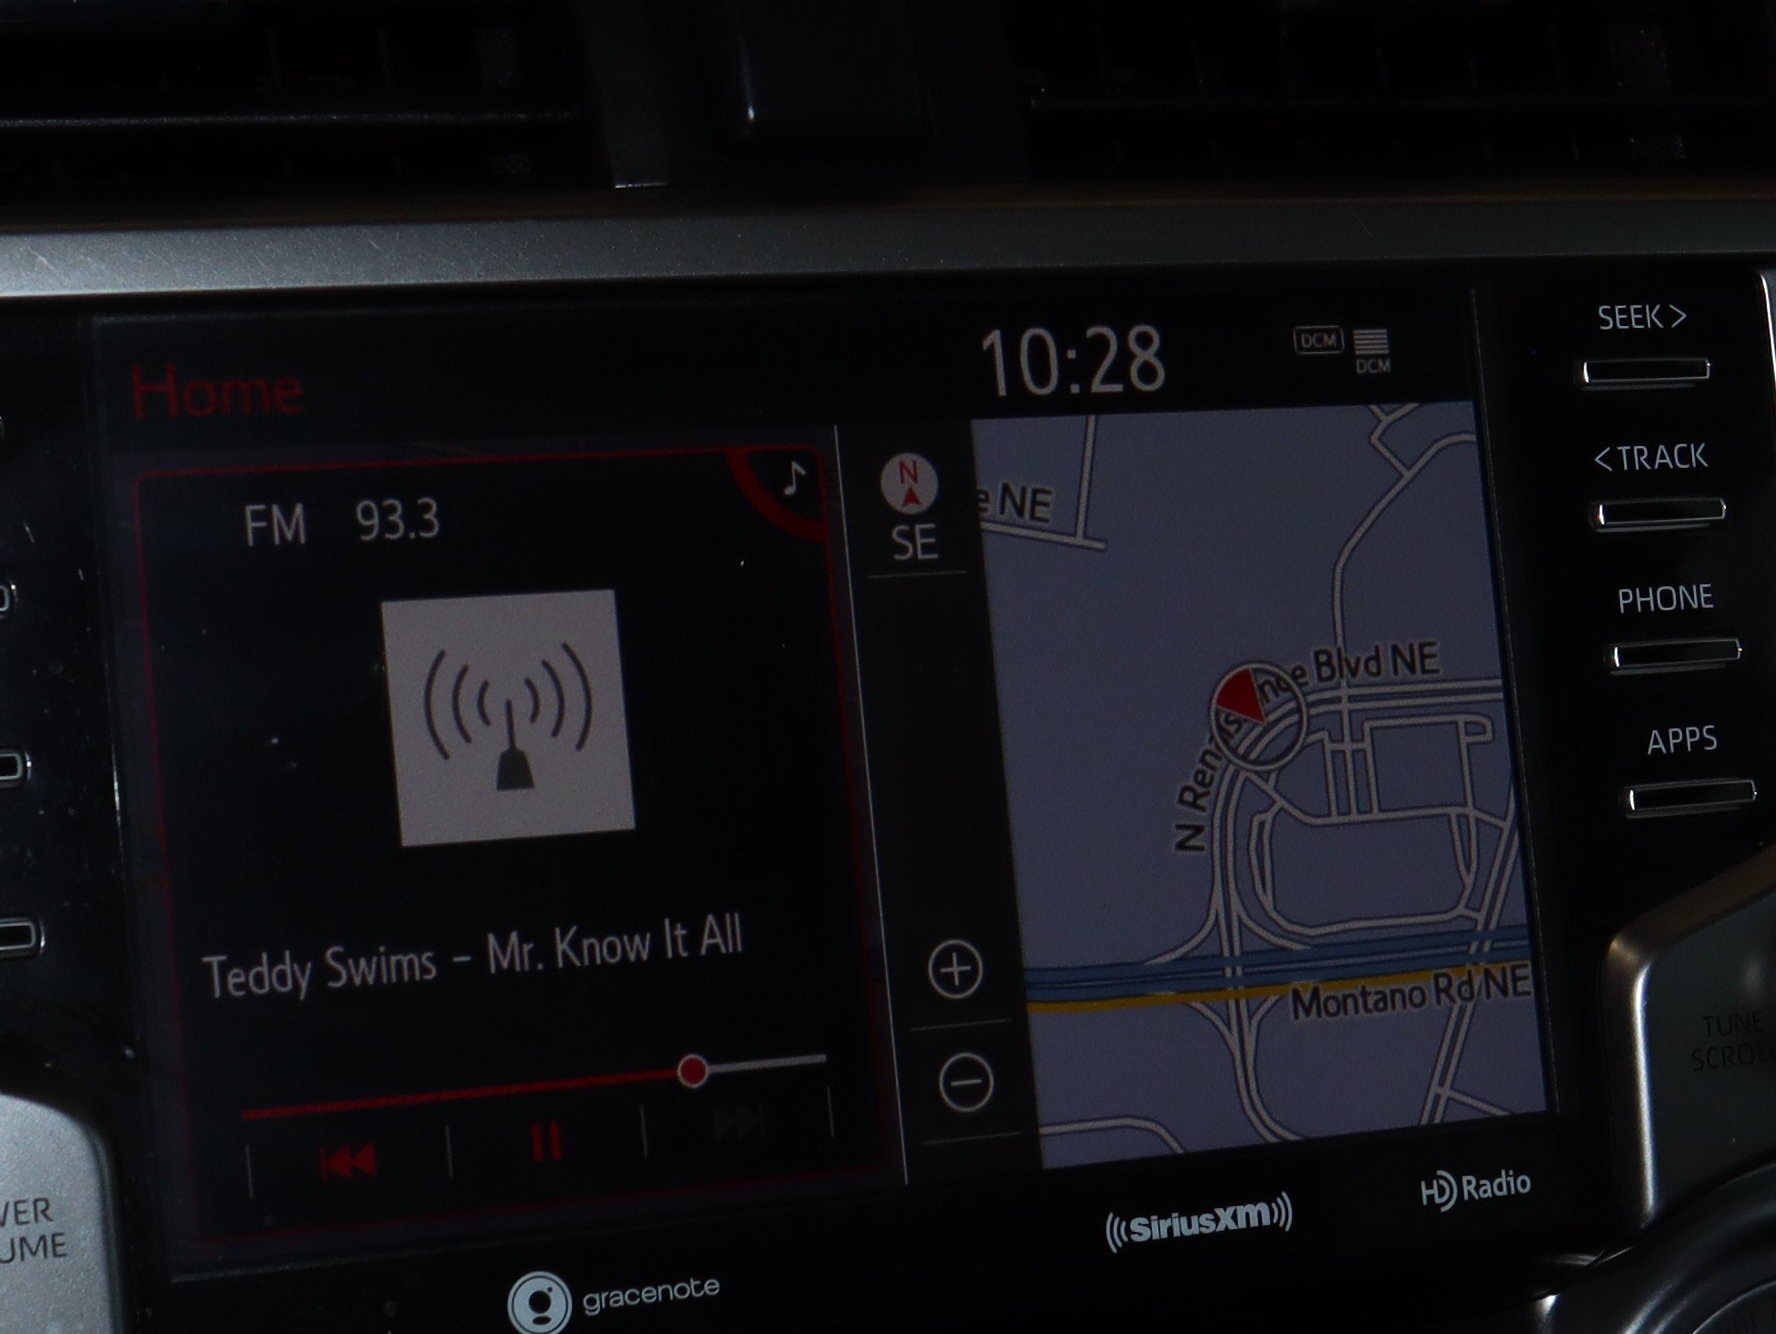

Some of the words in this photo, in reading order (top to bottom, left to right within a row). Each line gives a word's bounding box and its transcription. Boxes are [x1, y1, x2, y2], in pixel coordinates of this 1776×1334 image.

[1301, 331, 1337, 348] DCM
[979, 324, 1167, 398] 10:28
[1356, 357, 1392, 375] DCM
[131, 363, 305, 420] Home
[244, 502, 307, 547] FM
[355, 497, 441, 542] 93.3
[999, 482, 1053, 524] NE
[891, 523, 940, 561] SE
[1618, 583, 1715, 615] PHONE
[1313, 645, 1382, 683] Blvd
[1390, 641, 1440, 677] NE
[1647, 724, 1719, 756] APPS
[201, 949, 312, 1001] Teddy
[325, 945, 438, 989] Swims
[486, 929, 545, 975] Mr.
[554, 924, 651, 969] Know
[663, 917, 688, 960] It
[701, 912, 744, 955] All
[1291, 984, 1427, 1021] Montano
[1433, 969, 1474, 1006] Rd
[1482, 963, 1532, 1000] NE
[1702, 1009, 1765, 1038] TUNE
[1462, 1169, 1532, 1201] Radio
[582, 1277, 721, 1316] gracenote
